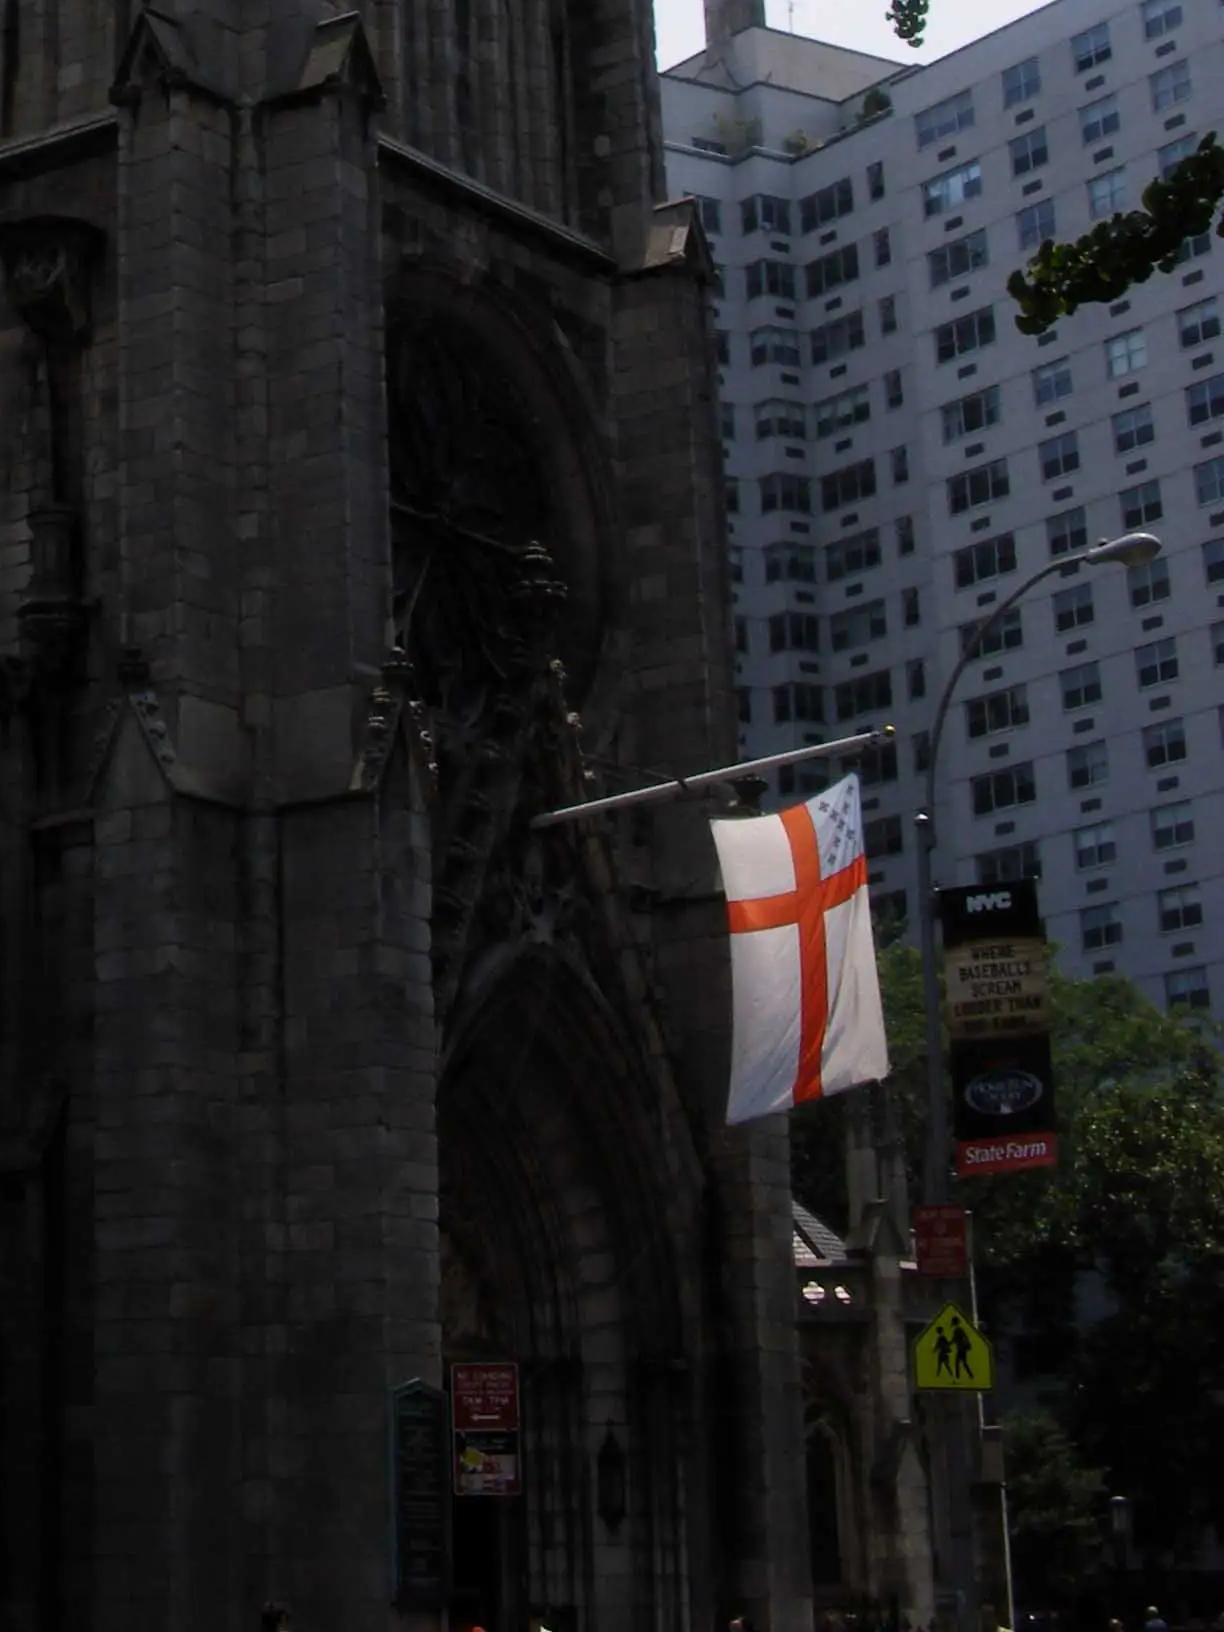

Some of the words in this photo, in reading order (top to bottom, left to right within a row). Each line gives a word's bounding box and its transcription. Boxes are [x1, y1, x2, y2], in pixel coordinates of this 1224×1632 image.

[966, 891, 1012, 913] NYC
[959, 961, 1032, 982] BASEBALLS
[971, 981, 1022, 998] SCREAM
